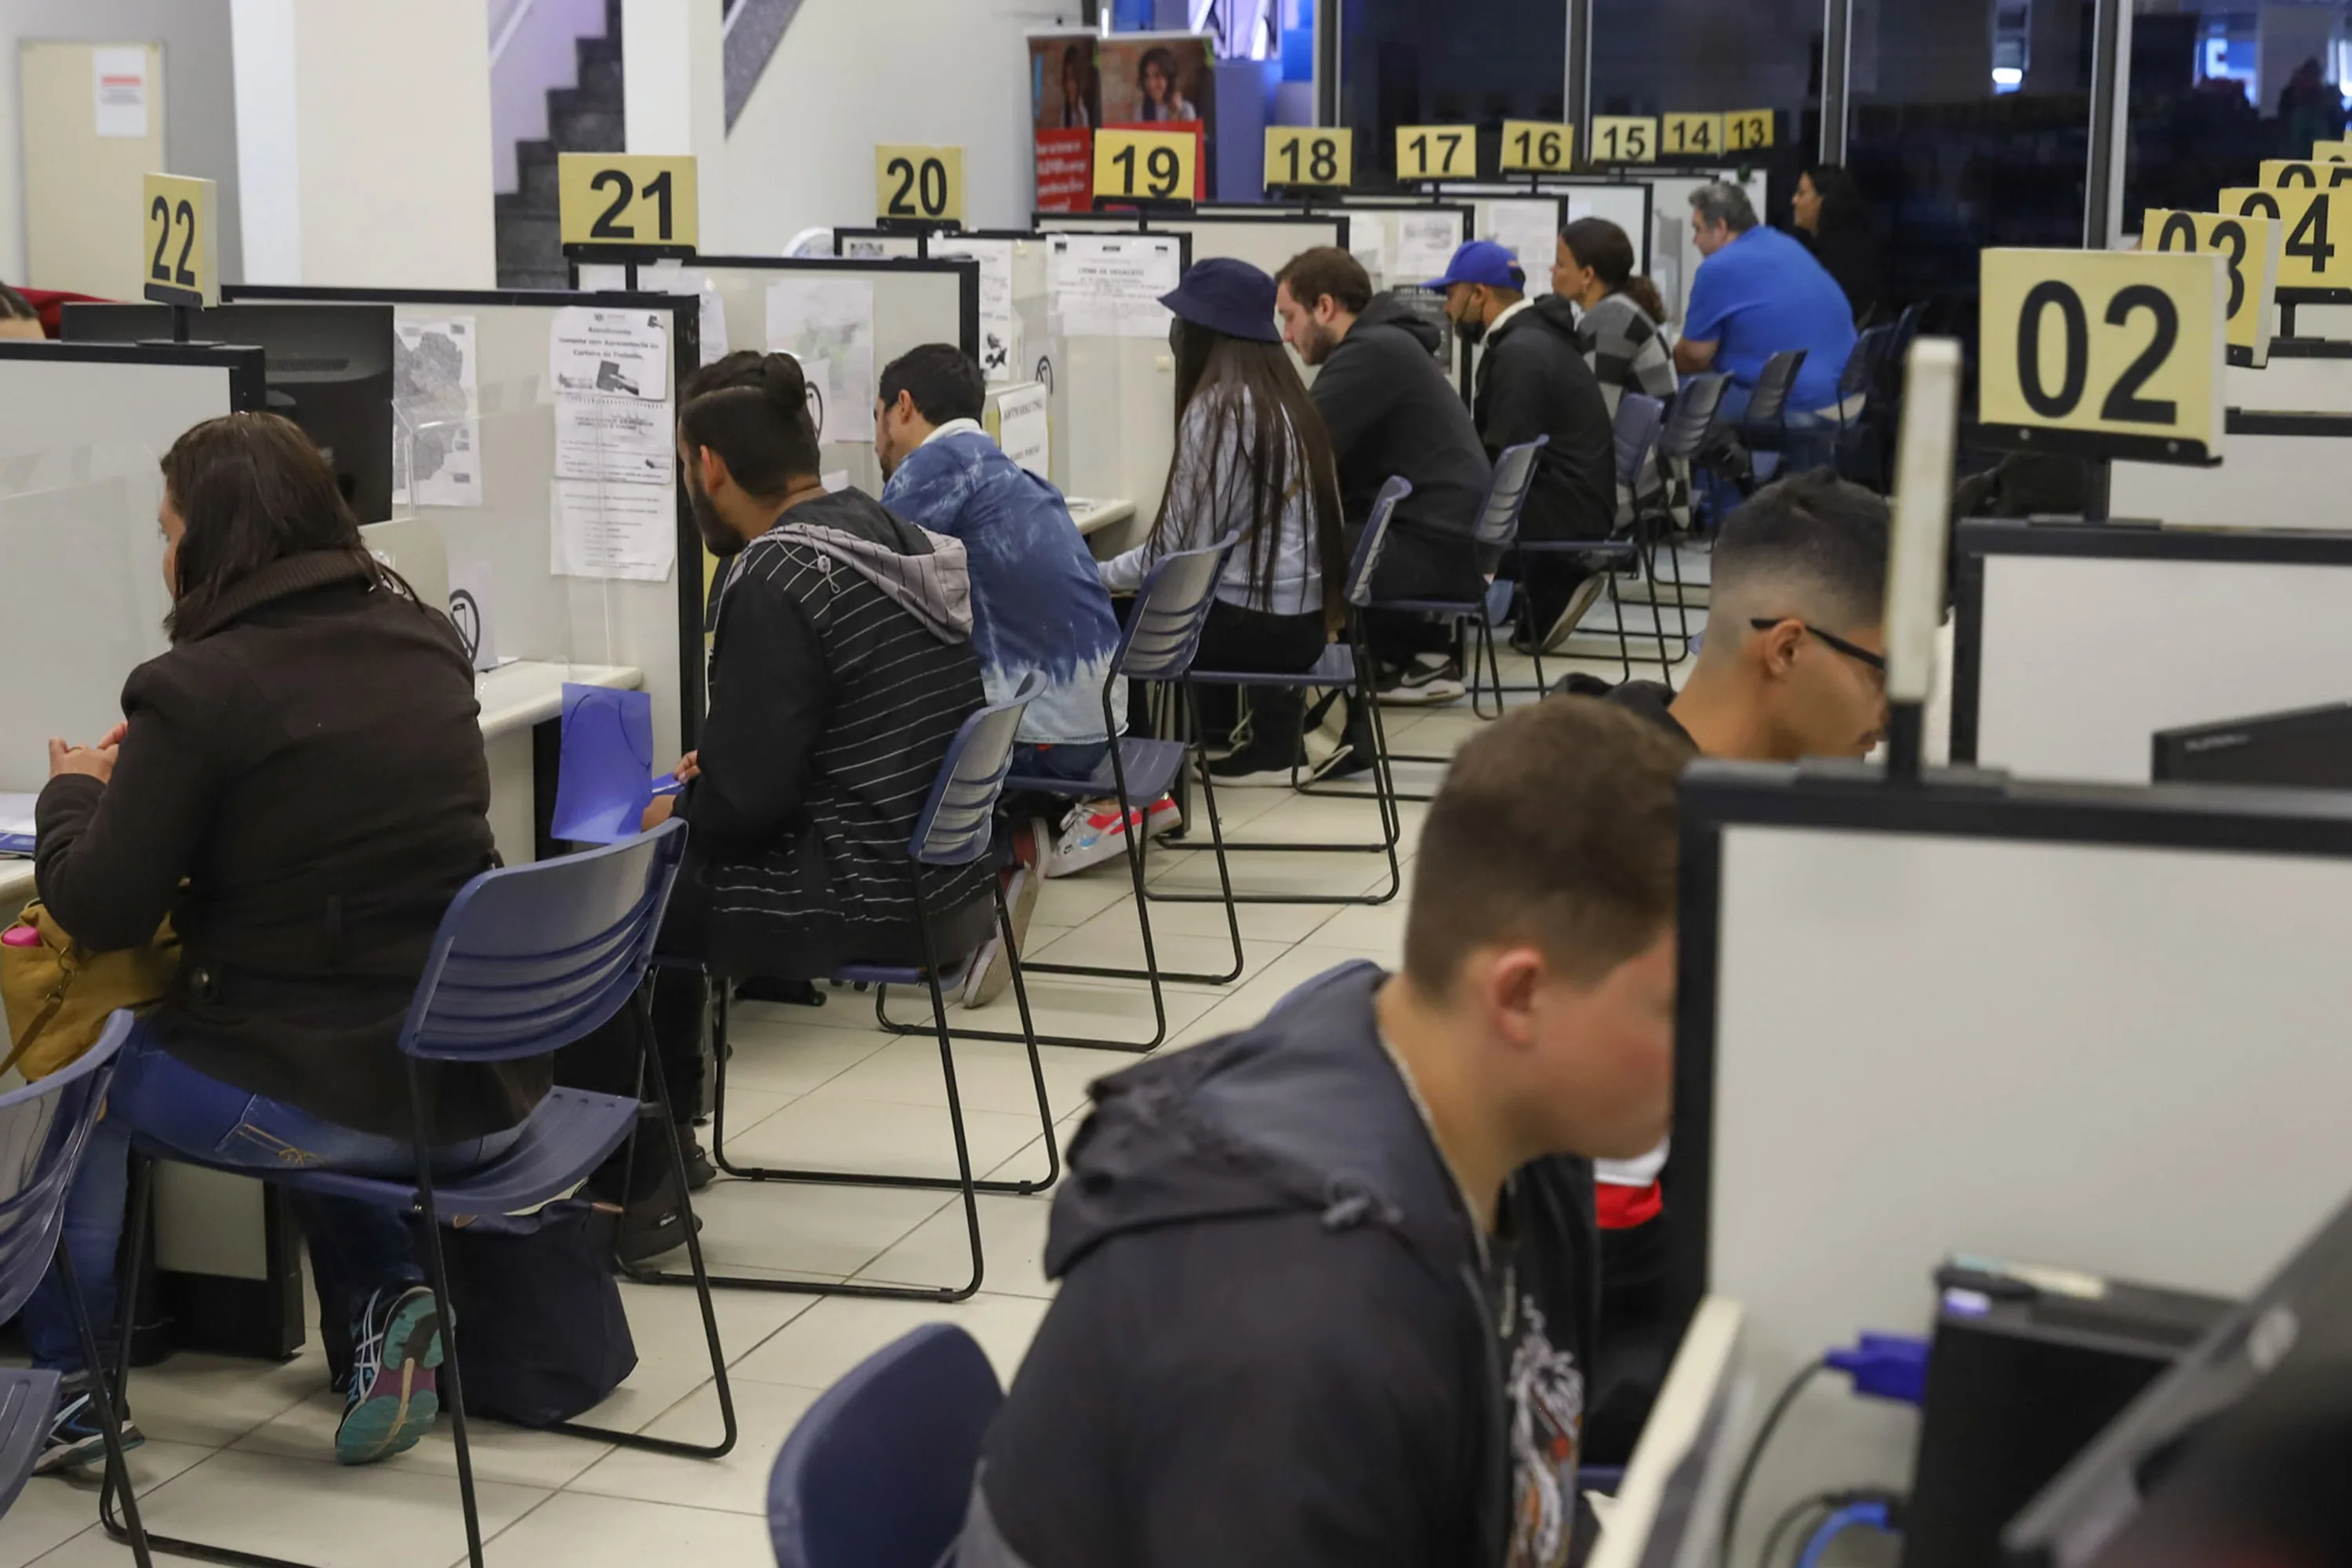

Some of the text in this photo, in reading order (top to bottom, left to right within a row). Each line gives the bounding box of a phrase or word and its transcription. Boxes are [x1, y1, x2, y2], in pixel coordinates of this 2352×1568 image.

[1409, 133, 1462, 172] 17
[1515, 130, 1560, 165] 16
[1604, 125, 1645, 158] 15
[1673, 120, 1710, 151] 14
[1733, 118, 1764, 147] 13
[1112, 144, 1180, 199] 19
[1280, 137, 1337, 182] 18
[590, 170, 672, 240] 21
[887, 158, 947, 216] 20
[151, 195, 195, 287] 22
[2016, 280, 2179, 425] 02
